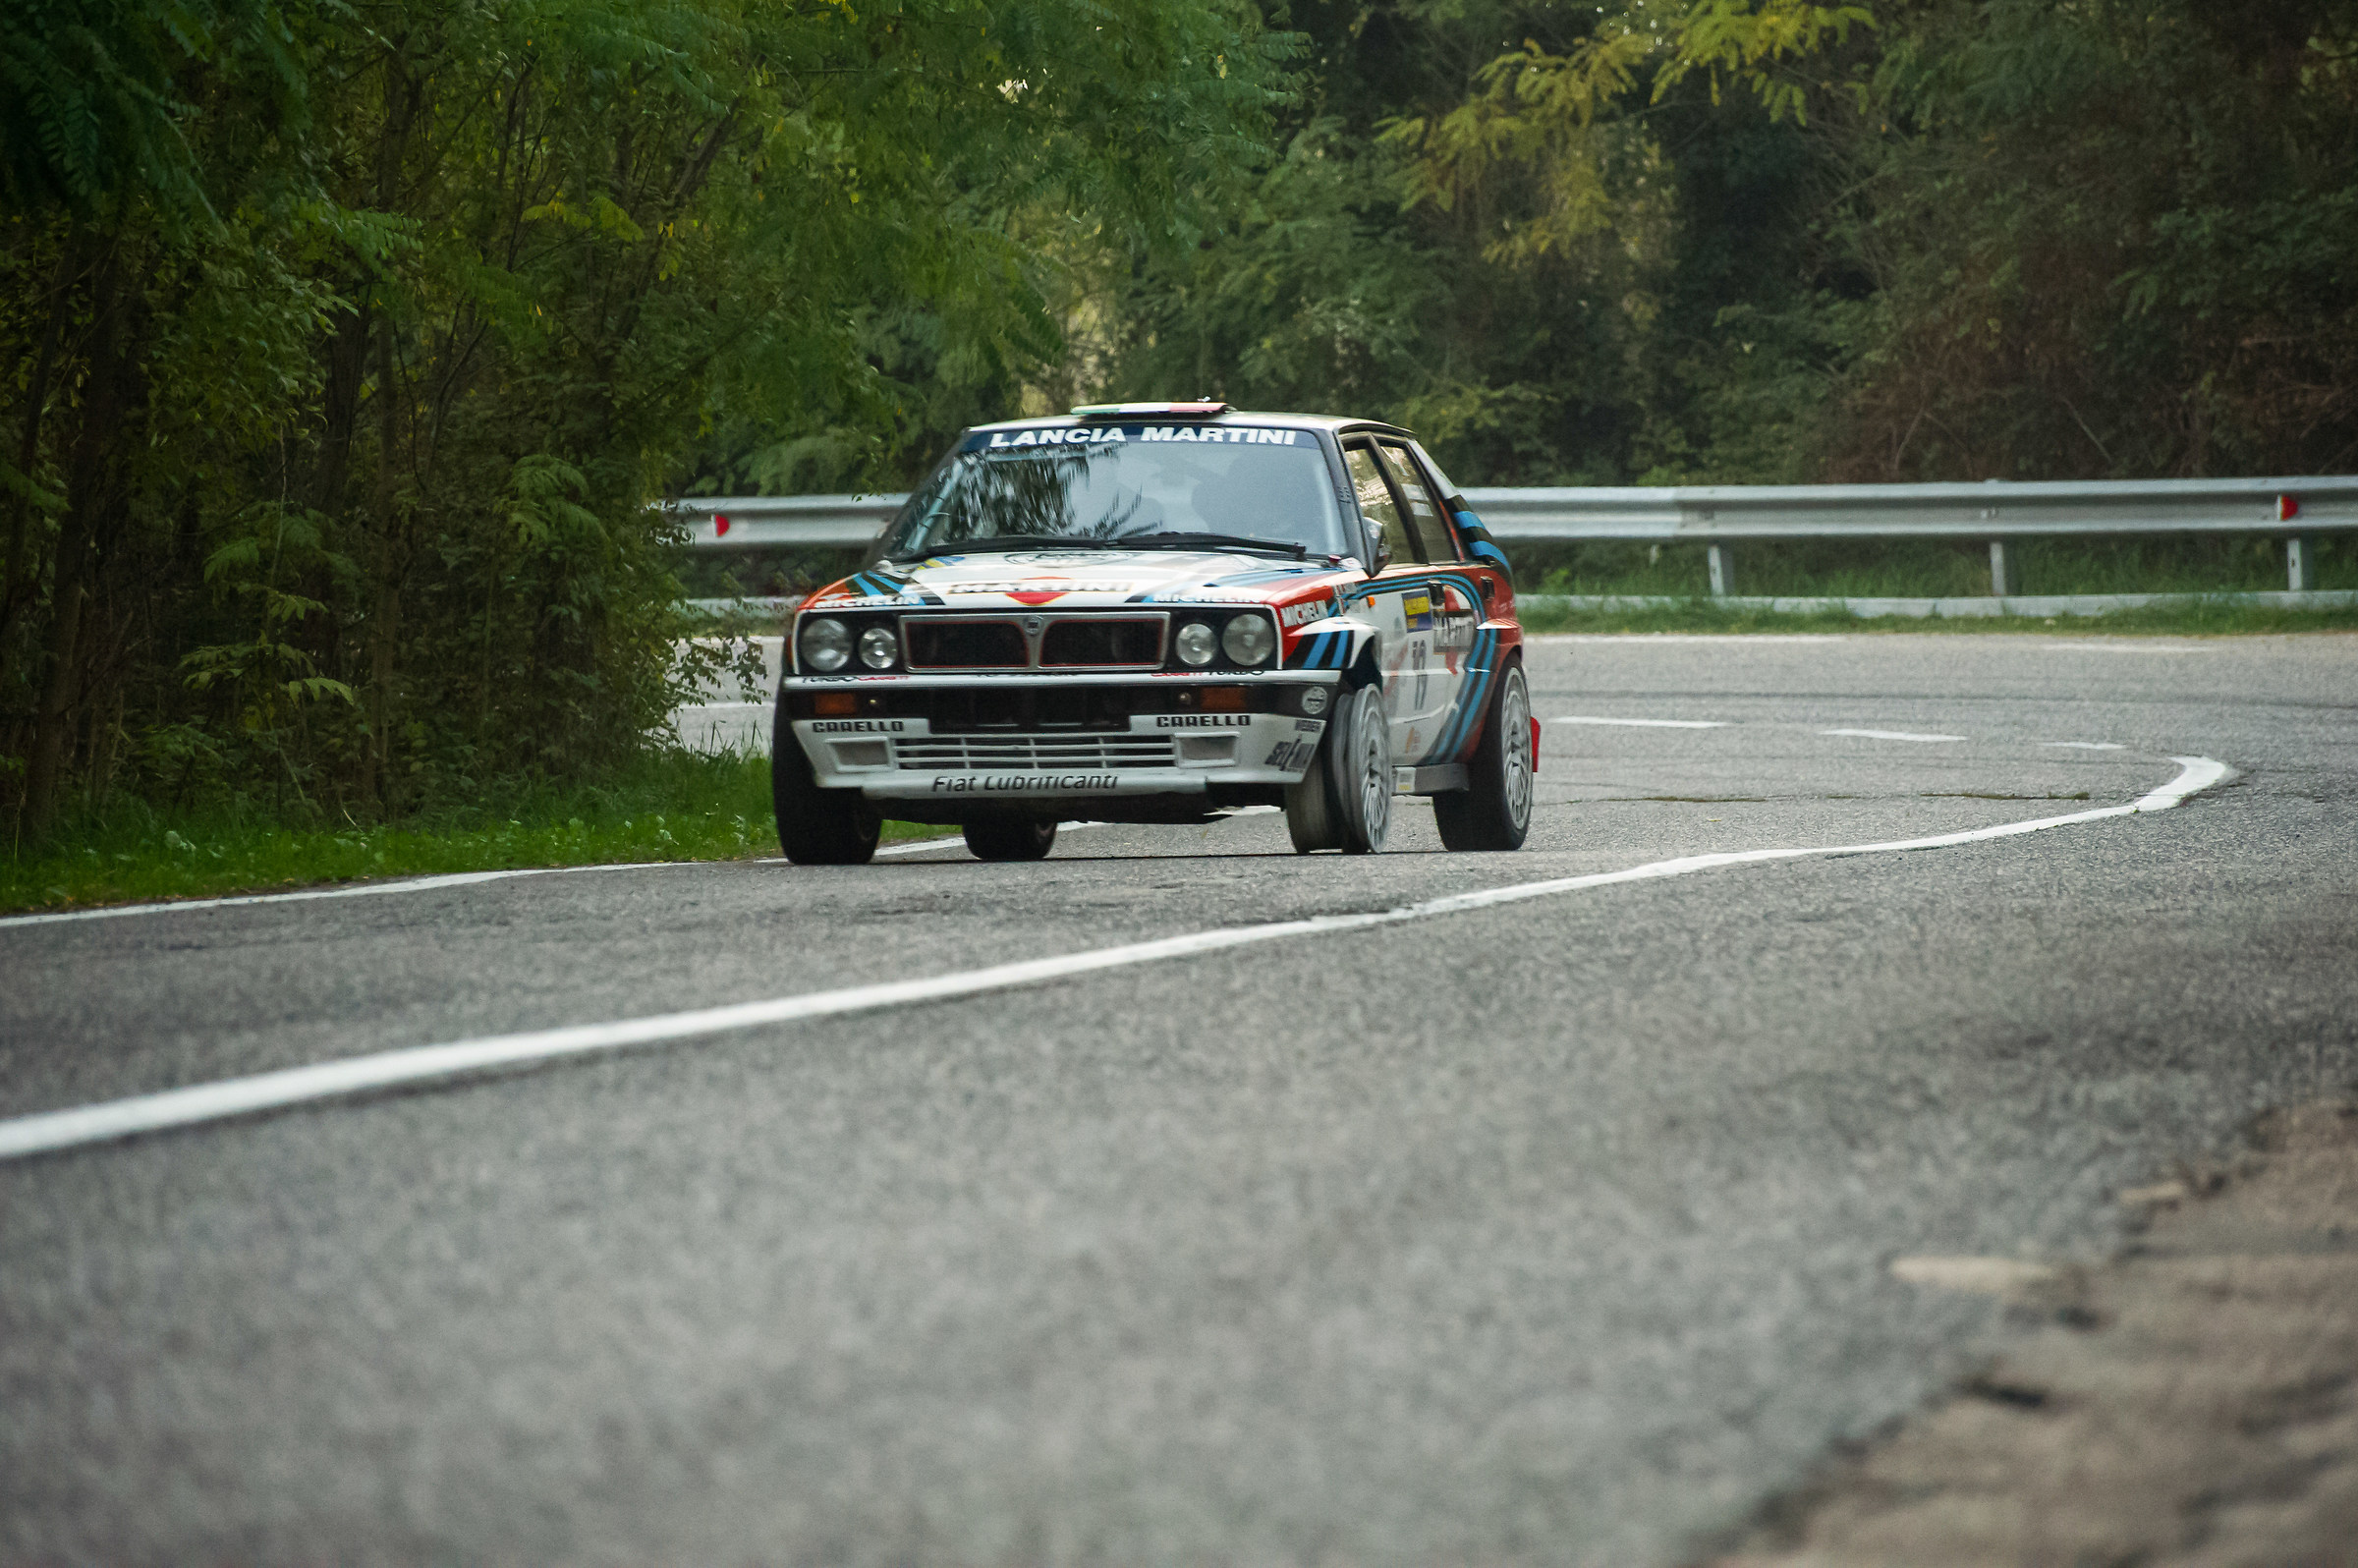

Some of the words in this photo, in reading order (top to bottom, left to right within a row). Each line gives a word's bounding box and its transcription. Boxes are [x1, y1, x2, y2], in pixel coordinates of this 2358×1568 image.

[989, 427, 1127, 448] LANCIA
[1140, 426, 1296, 445] MARTINI
[812, 721, 905, 734] CARELLO
[1156, 715, 1251, 727] CARELLO
[931, 775, 978, 793] Fiat
[983, 772, 1119, 791] Lubrificanti
